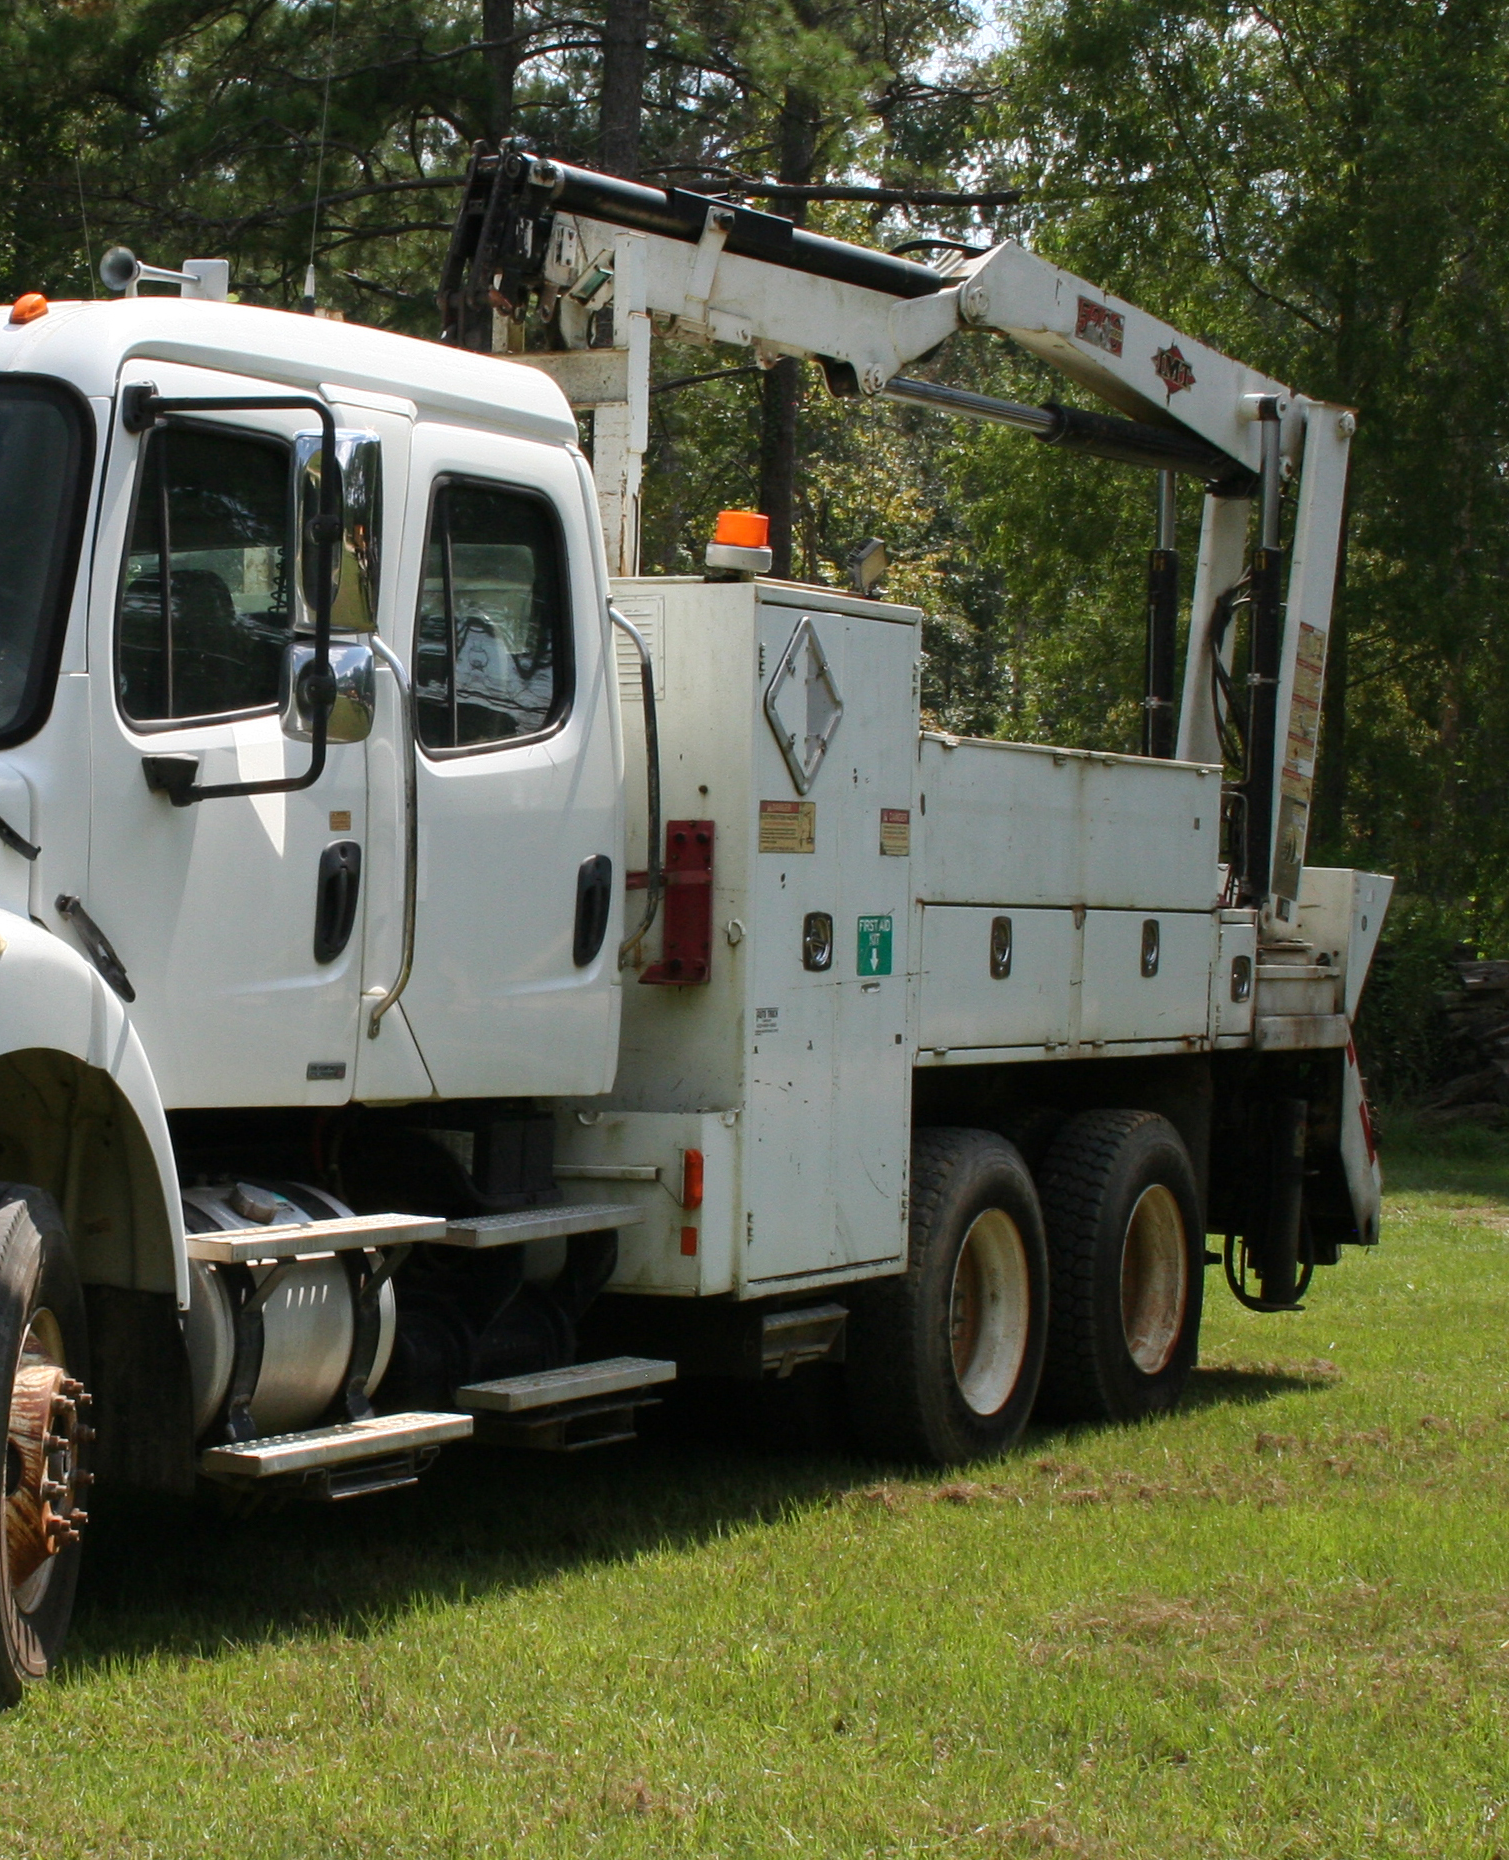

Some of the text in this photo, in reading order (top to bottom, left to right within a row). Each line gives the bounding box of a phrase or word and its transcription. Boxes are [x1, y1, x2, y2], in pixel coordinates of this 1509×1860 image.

[1159, 350, 1193, 386] IMT
[859, 919, 891, 932] FIRST AID
[869, 933, 880, 946] KIT
